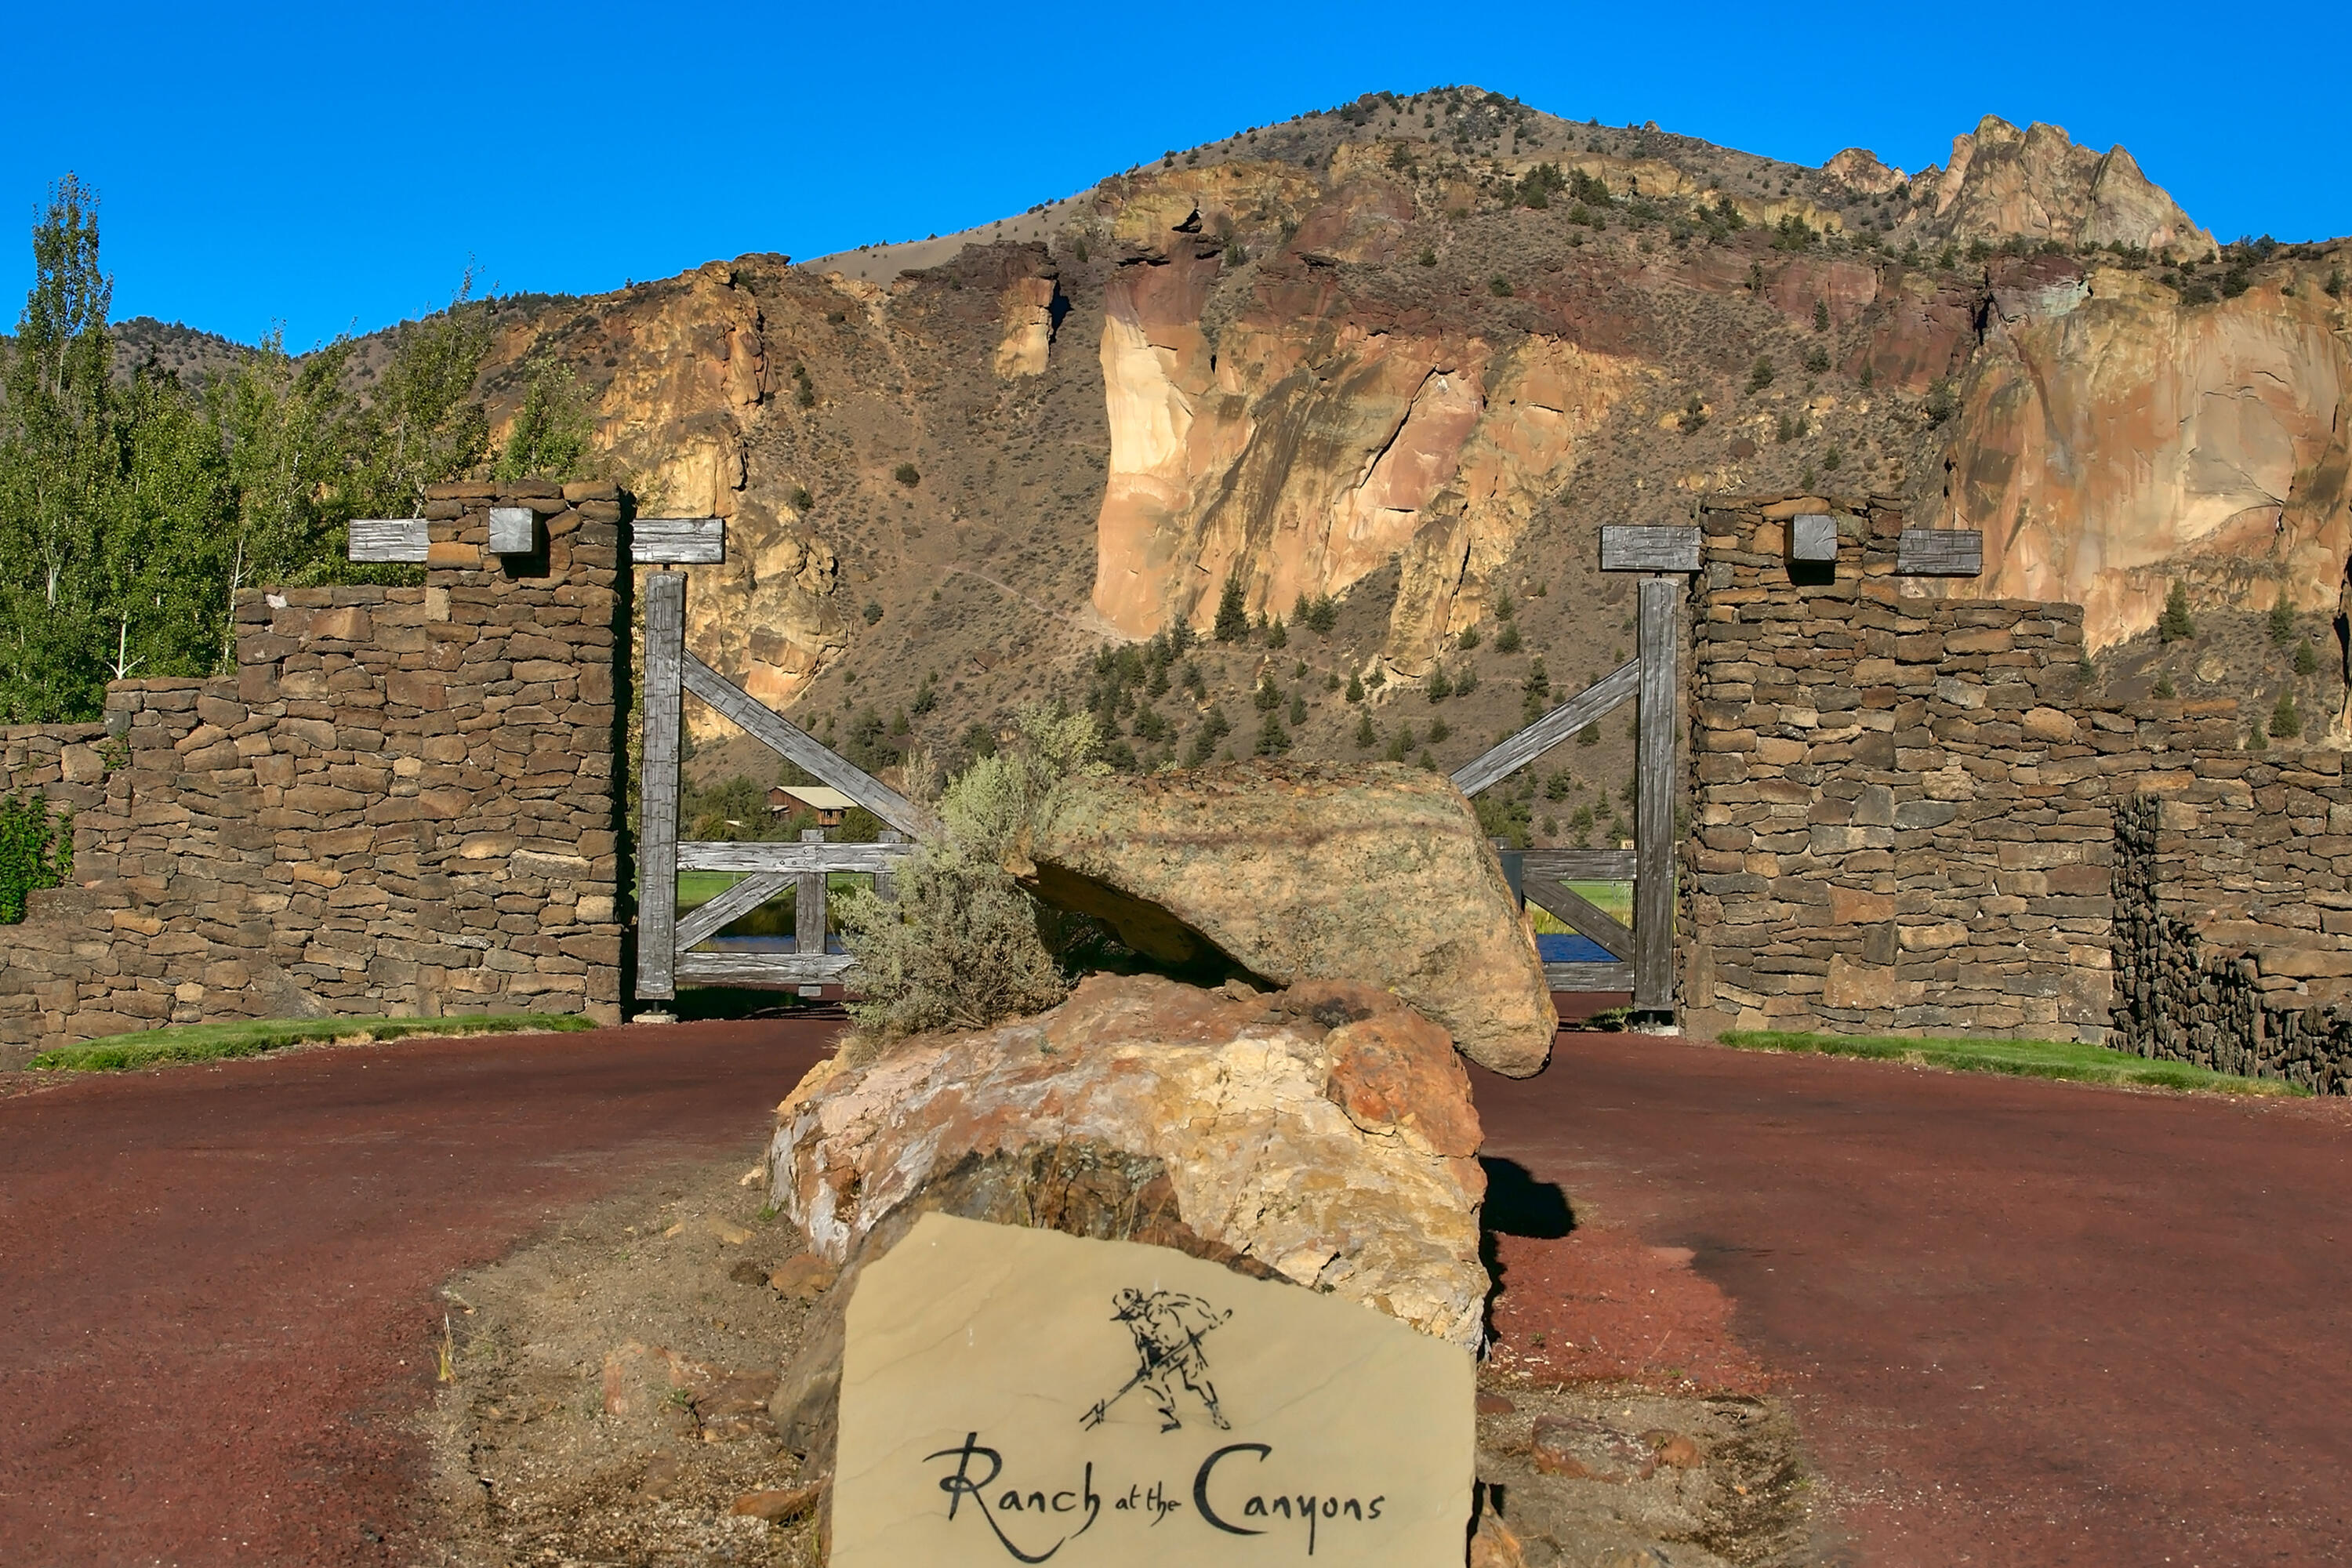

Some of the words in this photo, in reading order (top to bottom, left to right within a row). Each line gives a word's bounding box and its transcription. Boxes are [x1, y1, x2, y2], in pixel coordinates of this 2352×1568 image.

[922, 1432, 1101, 1564] Ranch
[1116, 1484, 1141, 1510] at
[1146, 1481, 1181, 1526] the
[1192, 1443, 1385, 1555] Canyons
